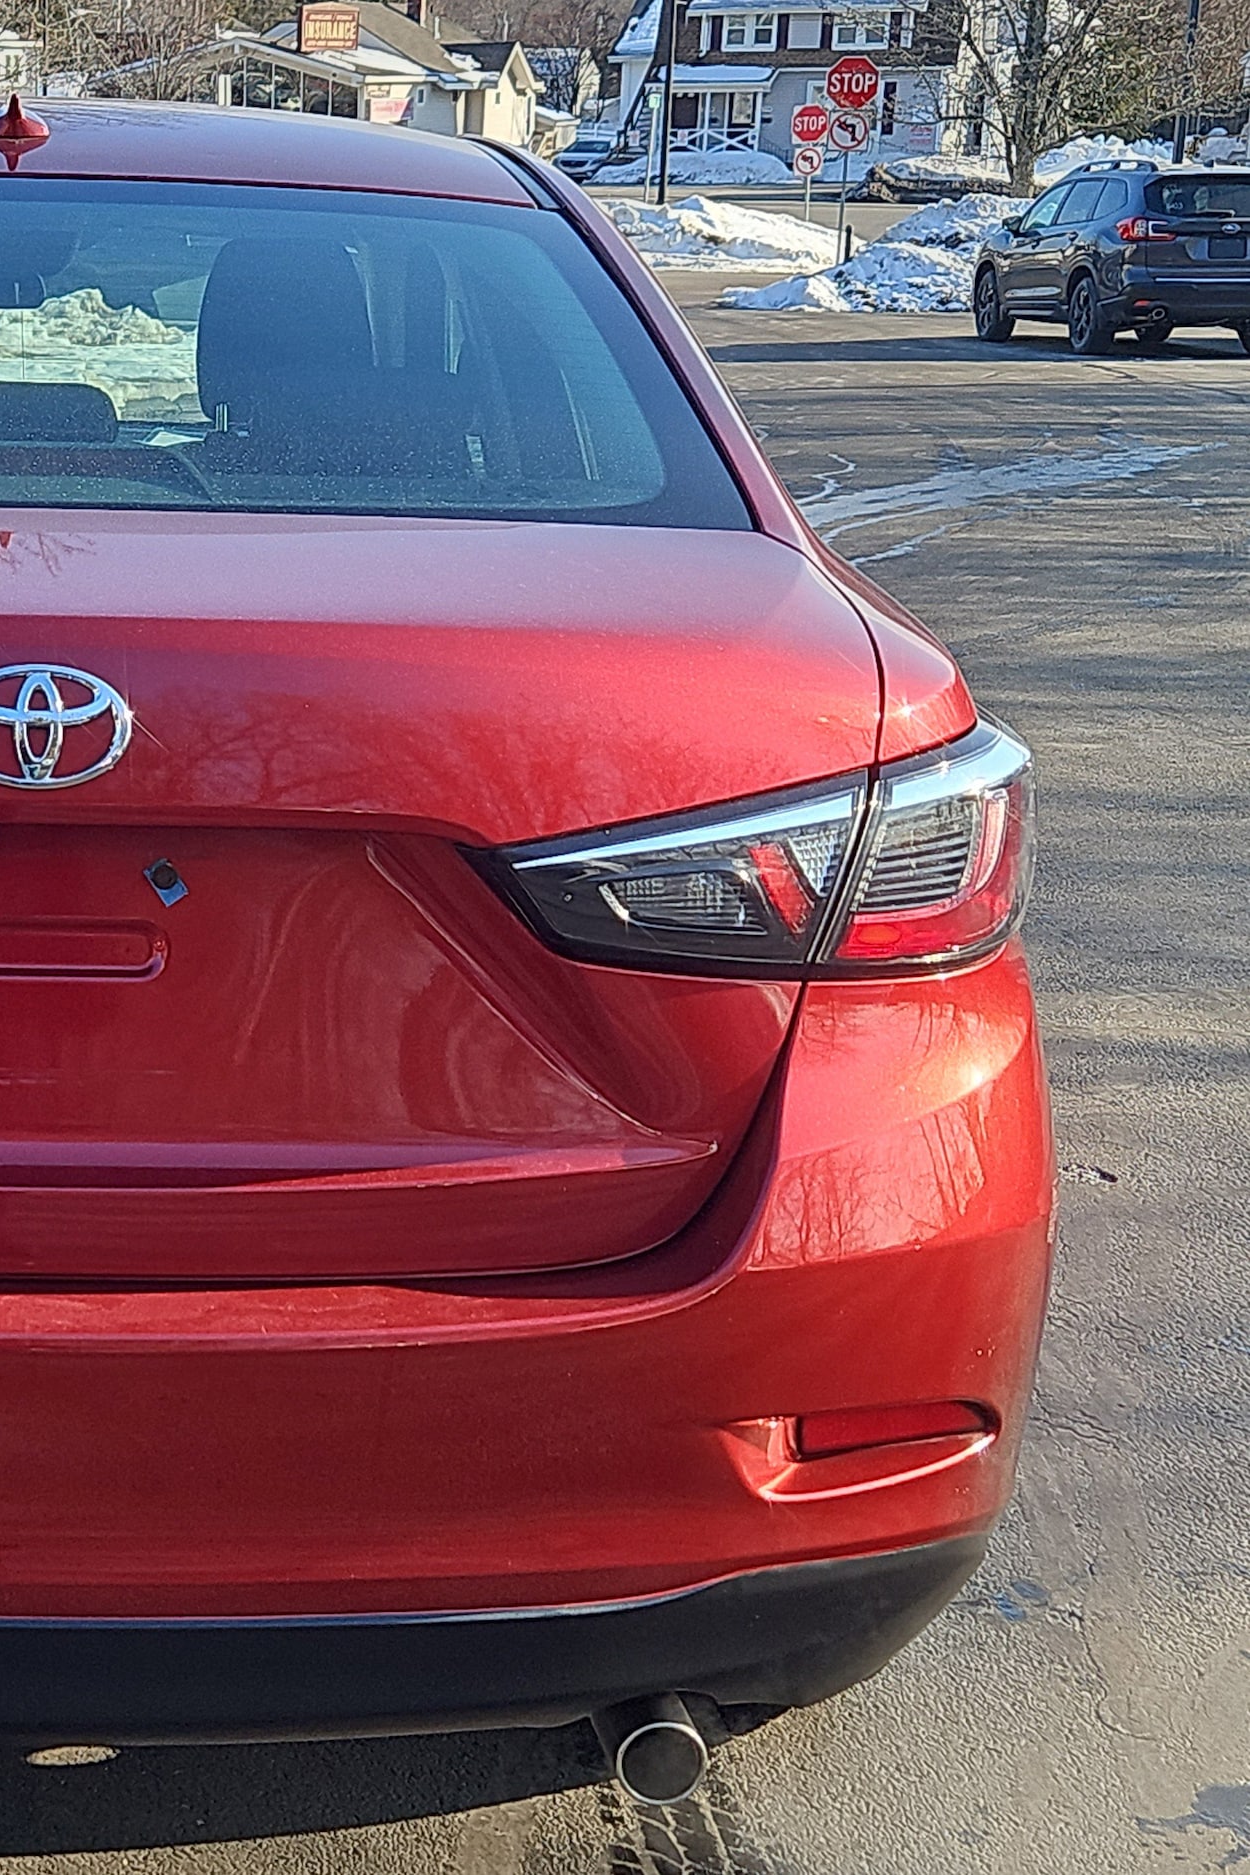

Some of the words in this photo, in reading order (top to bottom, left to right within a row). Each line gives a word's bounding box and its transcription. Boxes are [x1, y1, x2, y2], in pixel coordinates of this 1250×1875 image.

[305, 20, 357, 40] INSURANCE
[830, 72, 876, 93] STOP
[794, 115, 826, 132] STOP
